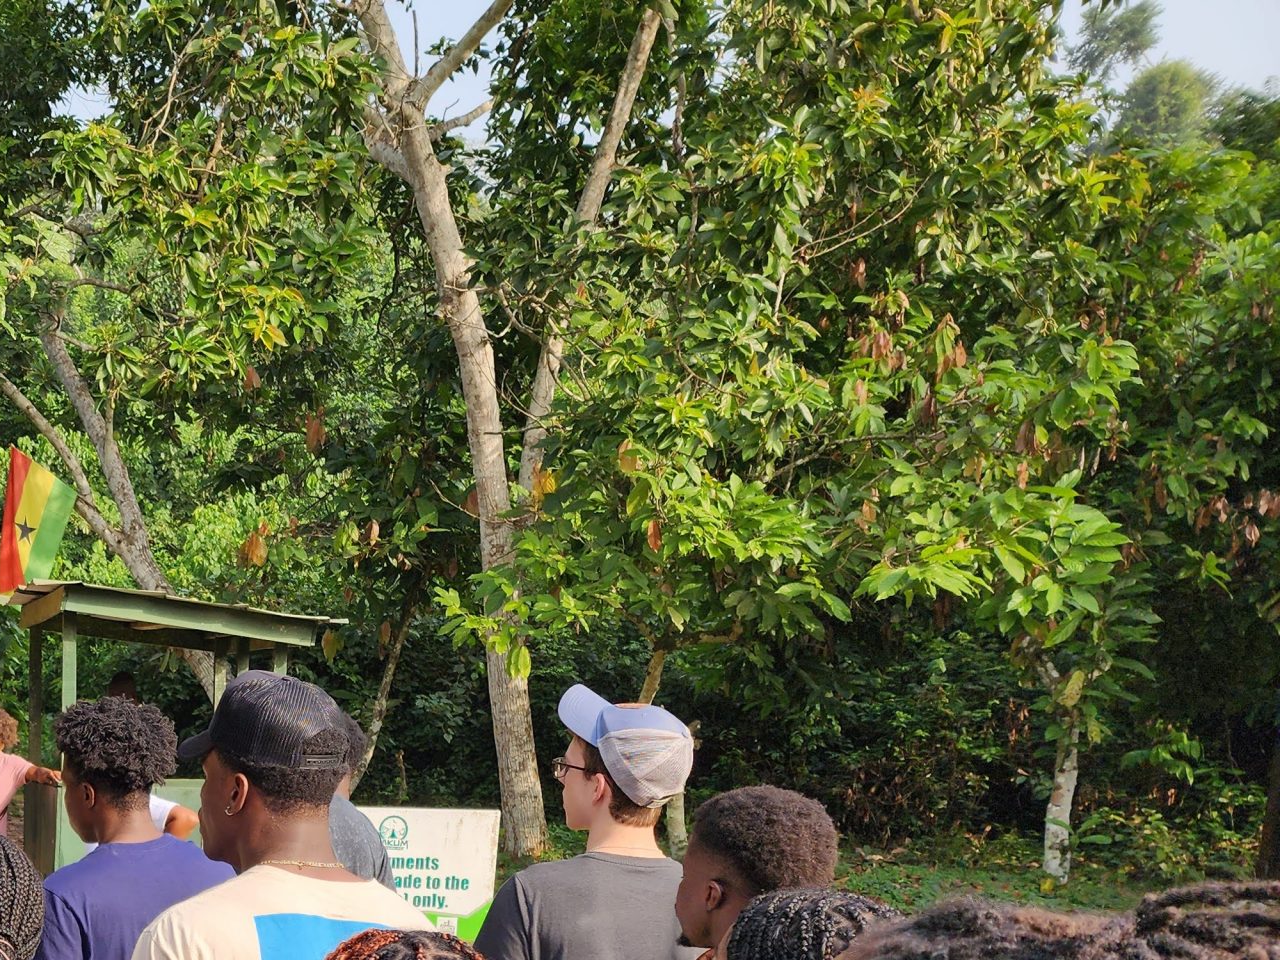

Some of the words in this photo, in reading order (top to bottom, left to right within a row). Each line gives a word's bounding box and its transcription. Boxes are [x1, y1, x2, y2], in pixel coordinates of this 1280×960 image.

[388, 856, 439, 870] ments
[394, 874, 421, 889] ade
[426, 876, 440, 890] to
[445, 876, 469, 890] the
[412, 893, 448, 909] only.
